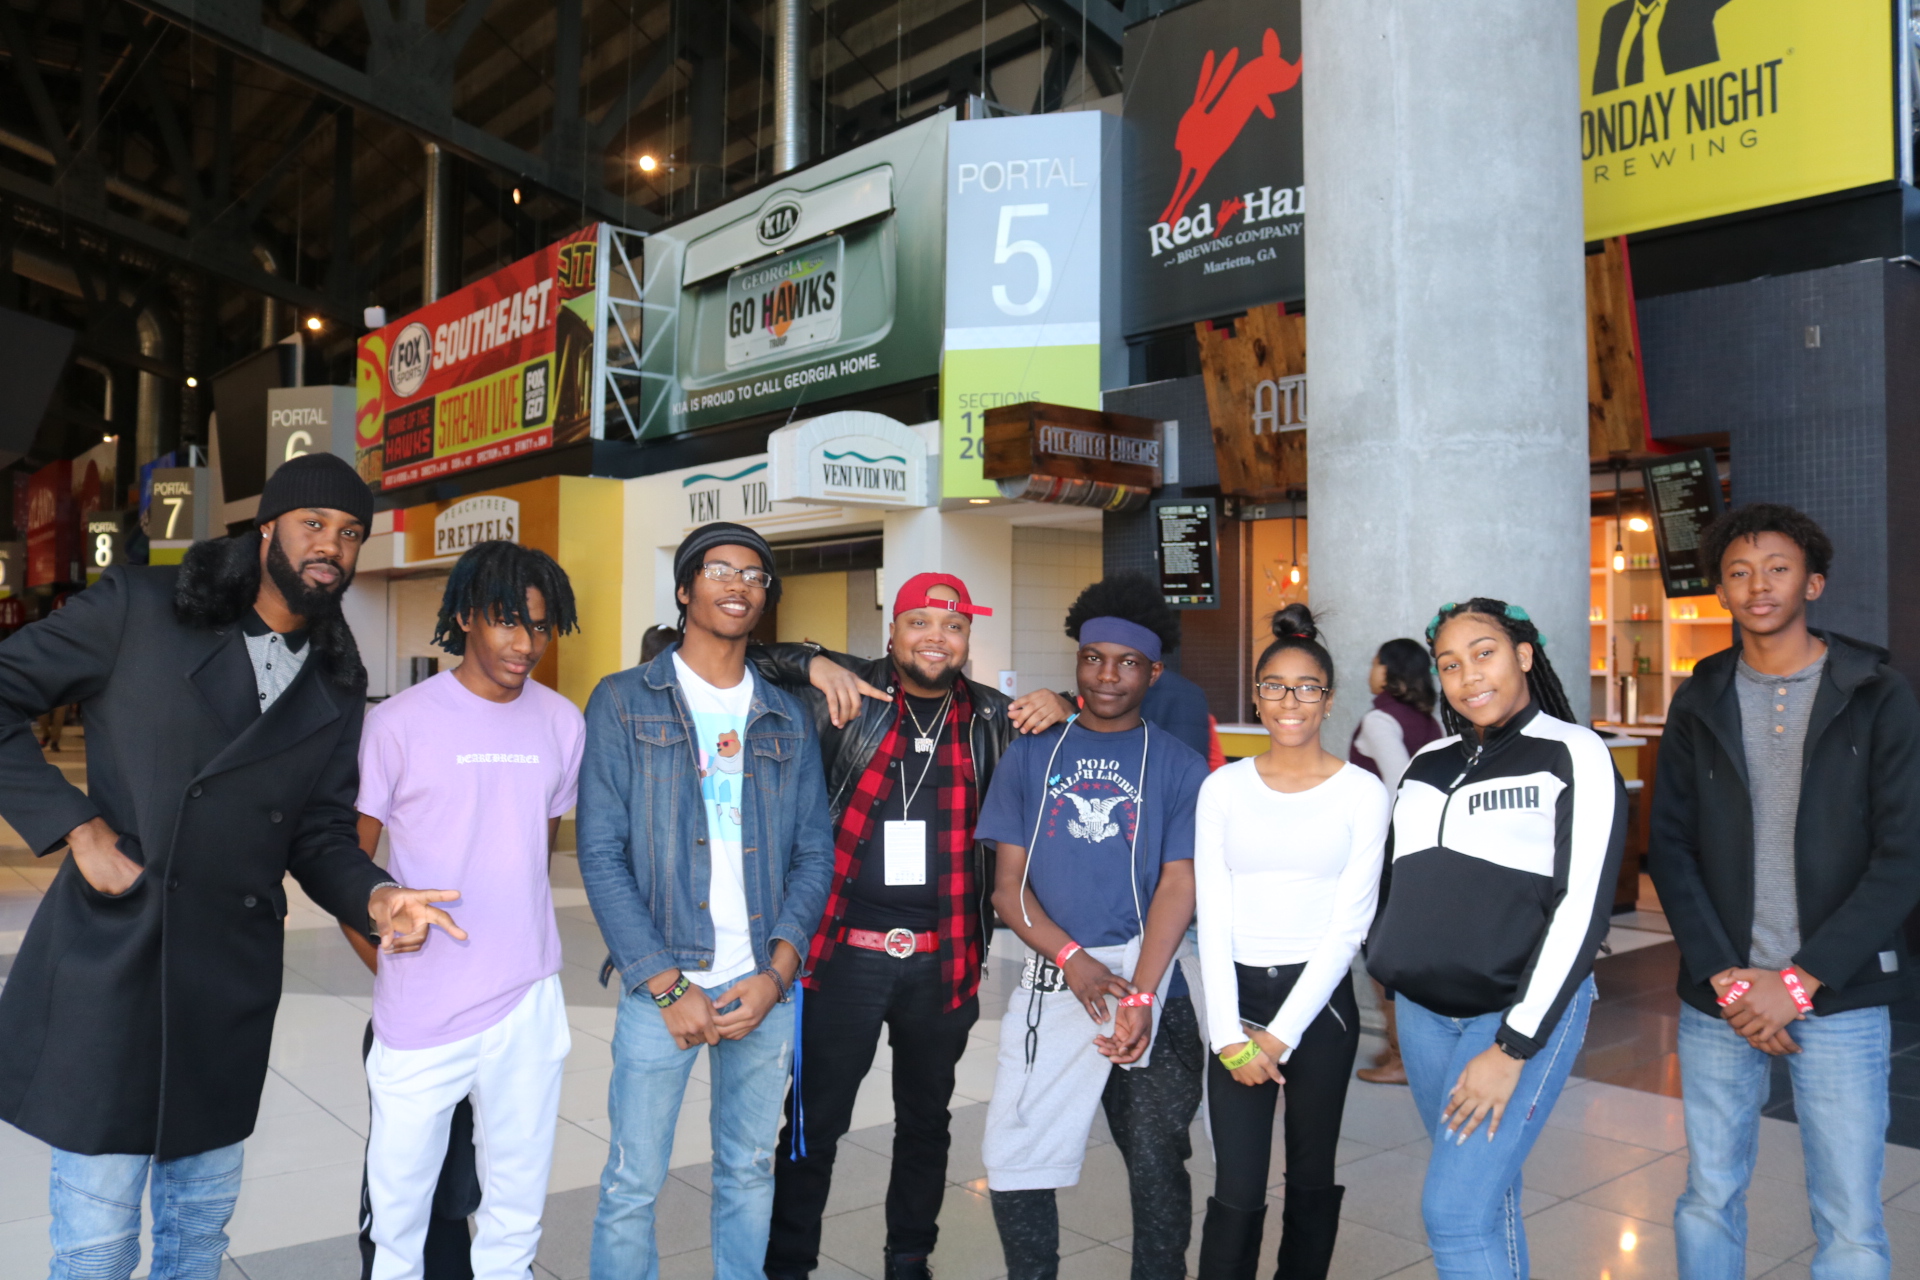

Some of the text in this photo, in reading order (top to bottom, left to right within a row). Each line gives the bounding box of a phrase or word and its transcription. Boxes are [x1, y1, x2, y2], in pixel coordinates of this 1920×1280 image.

[1686, 58, 1783, 135] NIGHT
[958, 156, 1088, 194] PORTAL
[764, 207, 794, 239] KIA
[1148, 203, 1215, 257] Red
[1176, 222, 1303, 264] BREWING COMPANY
[742, 259, 803, 291] GEORGIA
[991, 203, 1053, 317] 5
[1203, 247, 1278, 275] Marietta, GA
[729, 270, 836, 338] GO HAWKS
[433, 277, 554, 370] SOUTHEAST
[397, 335, 422, 369] FOX
[396, 366, 422, 386] SPORTS
[526, 367, 546, 391] FOX
[671, 353, 881, 416] KIA IS PROUD TO CALL GEORGIA HOME.
[271, 408, 327, 428] PORTAL
[438, 373, 519, 449] STREAM LIVE
[525, 396, 544, 420] GO
[385, 428, 431, 464] HAWKS
[1039, 425, 1107, 460] ATLANTA
[153, 482, 192, 496] PORTAL
[822, 463, 907, 492] VENI VIDI VICI
[163, 498, 183, 539] 7
[444, 499, 507, 523] PEACHTREE
[689, 488, 721, 524] VENI
[89, 521, 119, 533] PORTAL
[437, 516, 515, 551] PRETZELS
[95, 534, 113, 567] 8
[1076, 758, 1120, 771] POLO
[1049, 769, 1094, 799] RALPH
[1469, 785, 1540, 816] PUMA
